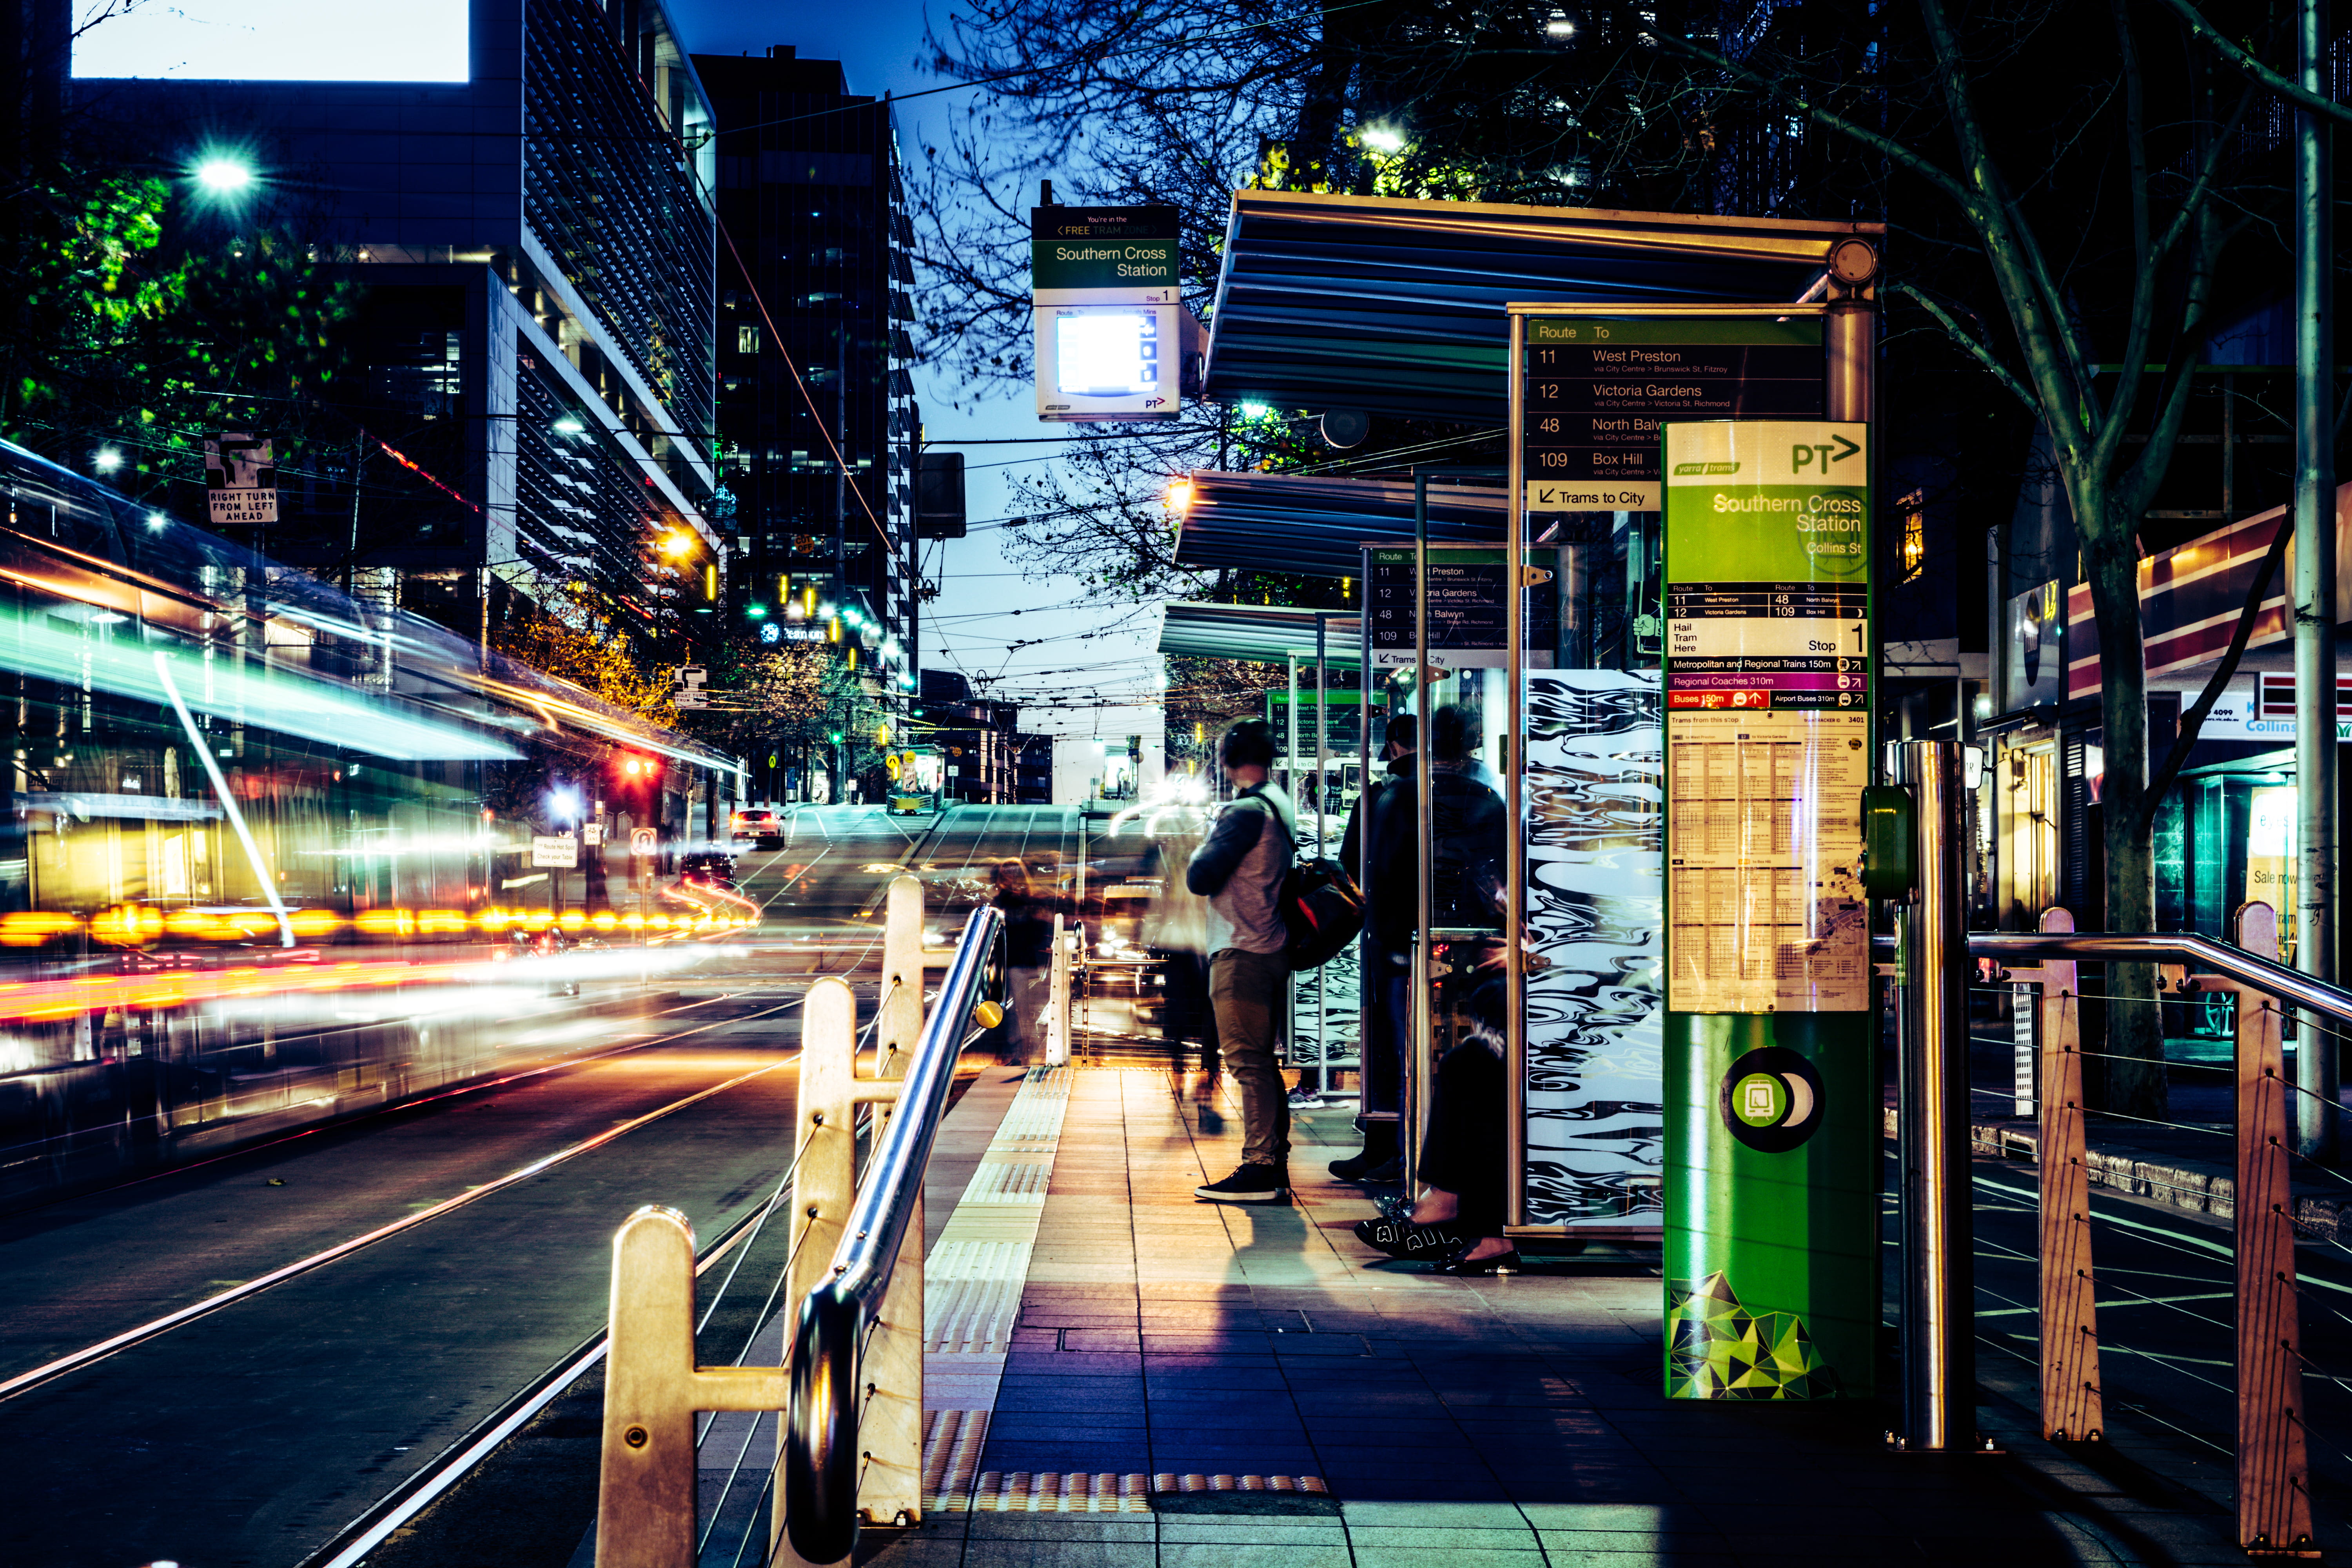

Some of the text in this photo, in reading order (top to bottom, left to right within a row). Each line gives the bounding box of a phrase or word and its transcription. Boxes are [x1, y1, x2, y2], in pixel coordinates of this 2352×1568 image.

[1066, 226, 1090, 234] FREE
[1124, 226, 1149, 234] ZONE
[1056, 247, 1166, 260] Southern Cross
[1117, 264, 1167, 276] Station
[1163, 290, 1168, 301] 1
[1540, 327, 1609, 339] Route To
[1540, 350, 1681, 364] 11 West Preston
[1540, 384, 1702, 398] 12 Victoria Gardens
[1606, 400, 1619, 408] City
[1540, 418, 1629, 432] 48 North
[1540, 453, 1642, 467] 109 Box Hill
[1679, 464, 1701, 474] yarra
[1559, 492, 1645, 506] Trams to City
[1713, 494, 1861, 513] Southern Cross
[226, 512, 262, 521] AHEAD
[1797, 514, 1861, 532] Station
[796, 536, 810, 544] CUT
[798, 543, 812, 552] OFF
[1807, 542, 1861, 554] Collins St
[1380, 568, 1388, 576] 11
[1380, 589, 1391, 597] 12
[1674, 595, 1685, 605] 11
[1775, 595, 1789, 604] 48
[1379, 610, 1392, 619] 48
[1435, 610, 1464, 619] Balwyn
[1674, 608, 1686, 617] 12
[1775, 607, 1795, 616] 109
[1379, 632, 1397, 640] 109
[1809, 623, 1862, 653] Stop 1
[1429, 656, 1445, 665] City
[1673, 661, 1724, 670] Metropolitan
[1726, 660, 1742, 668] and
[1744, 660, 1780, 670] Regional
[1674, 678, 1709, 687] Regional
[1702, 695, 1724, 703] 150m
[2255, 871, 2275, 884] Sale
[2278, 874, 2297, 884] now
